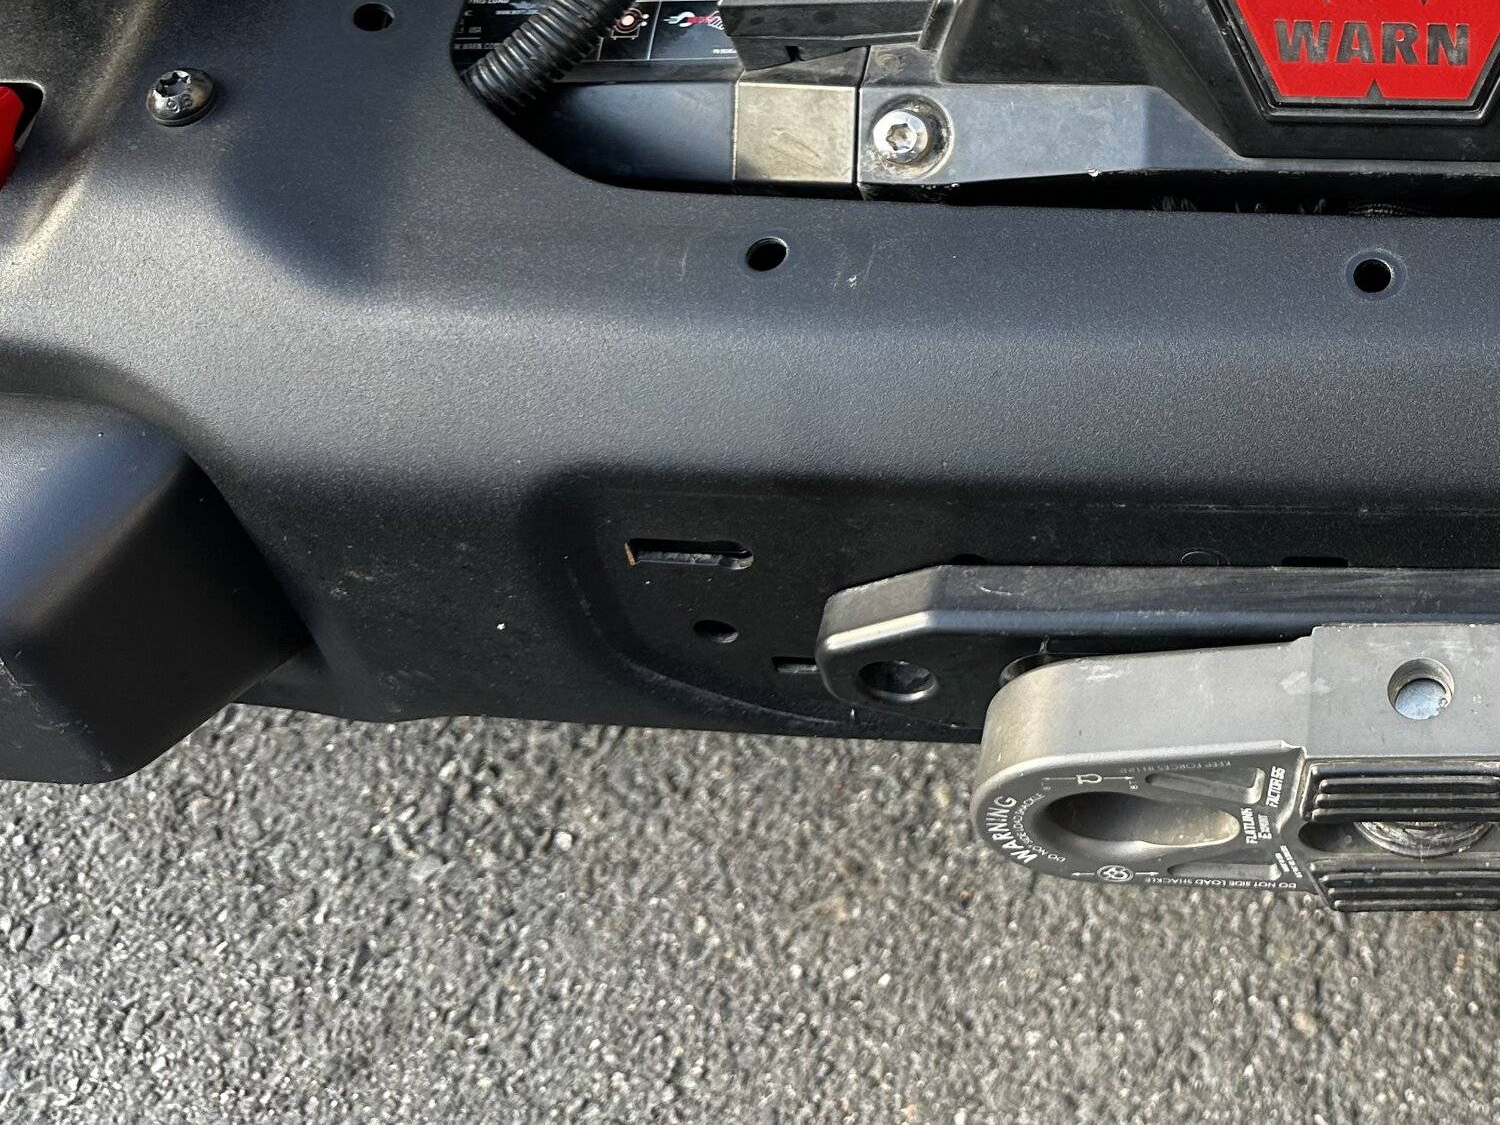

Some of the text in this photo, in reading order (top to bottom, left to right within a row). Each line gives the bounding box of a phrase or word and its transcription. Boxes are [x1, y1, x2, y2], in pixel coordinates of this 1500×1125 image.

[1273, 18, 1470, 67] WARN
[1265, 778, 1283, 807] FACTOR
[985, 795, 1038, 864] WARNING
[1195, 878, 1226, 887] LOAD
[1254, 880, 1276, 889] NOT
[1278, 881, 1297, 890] DO
